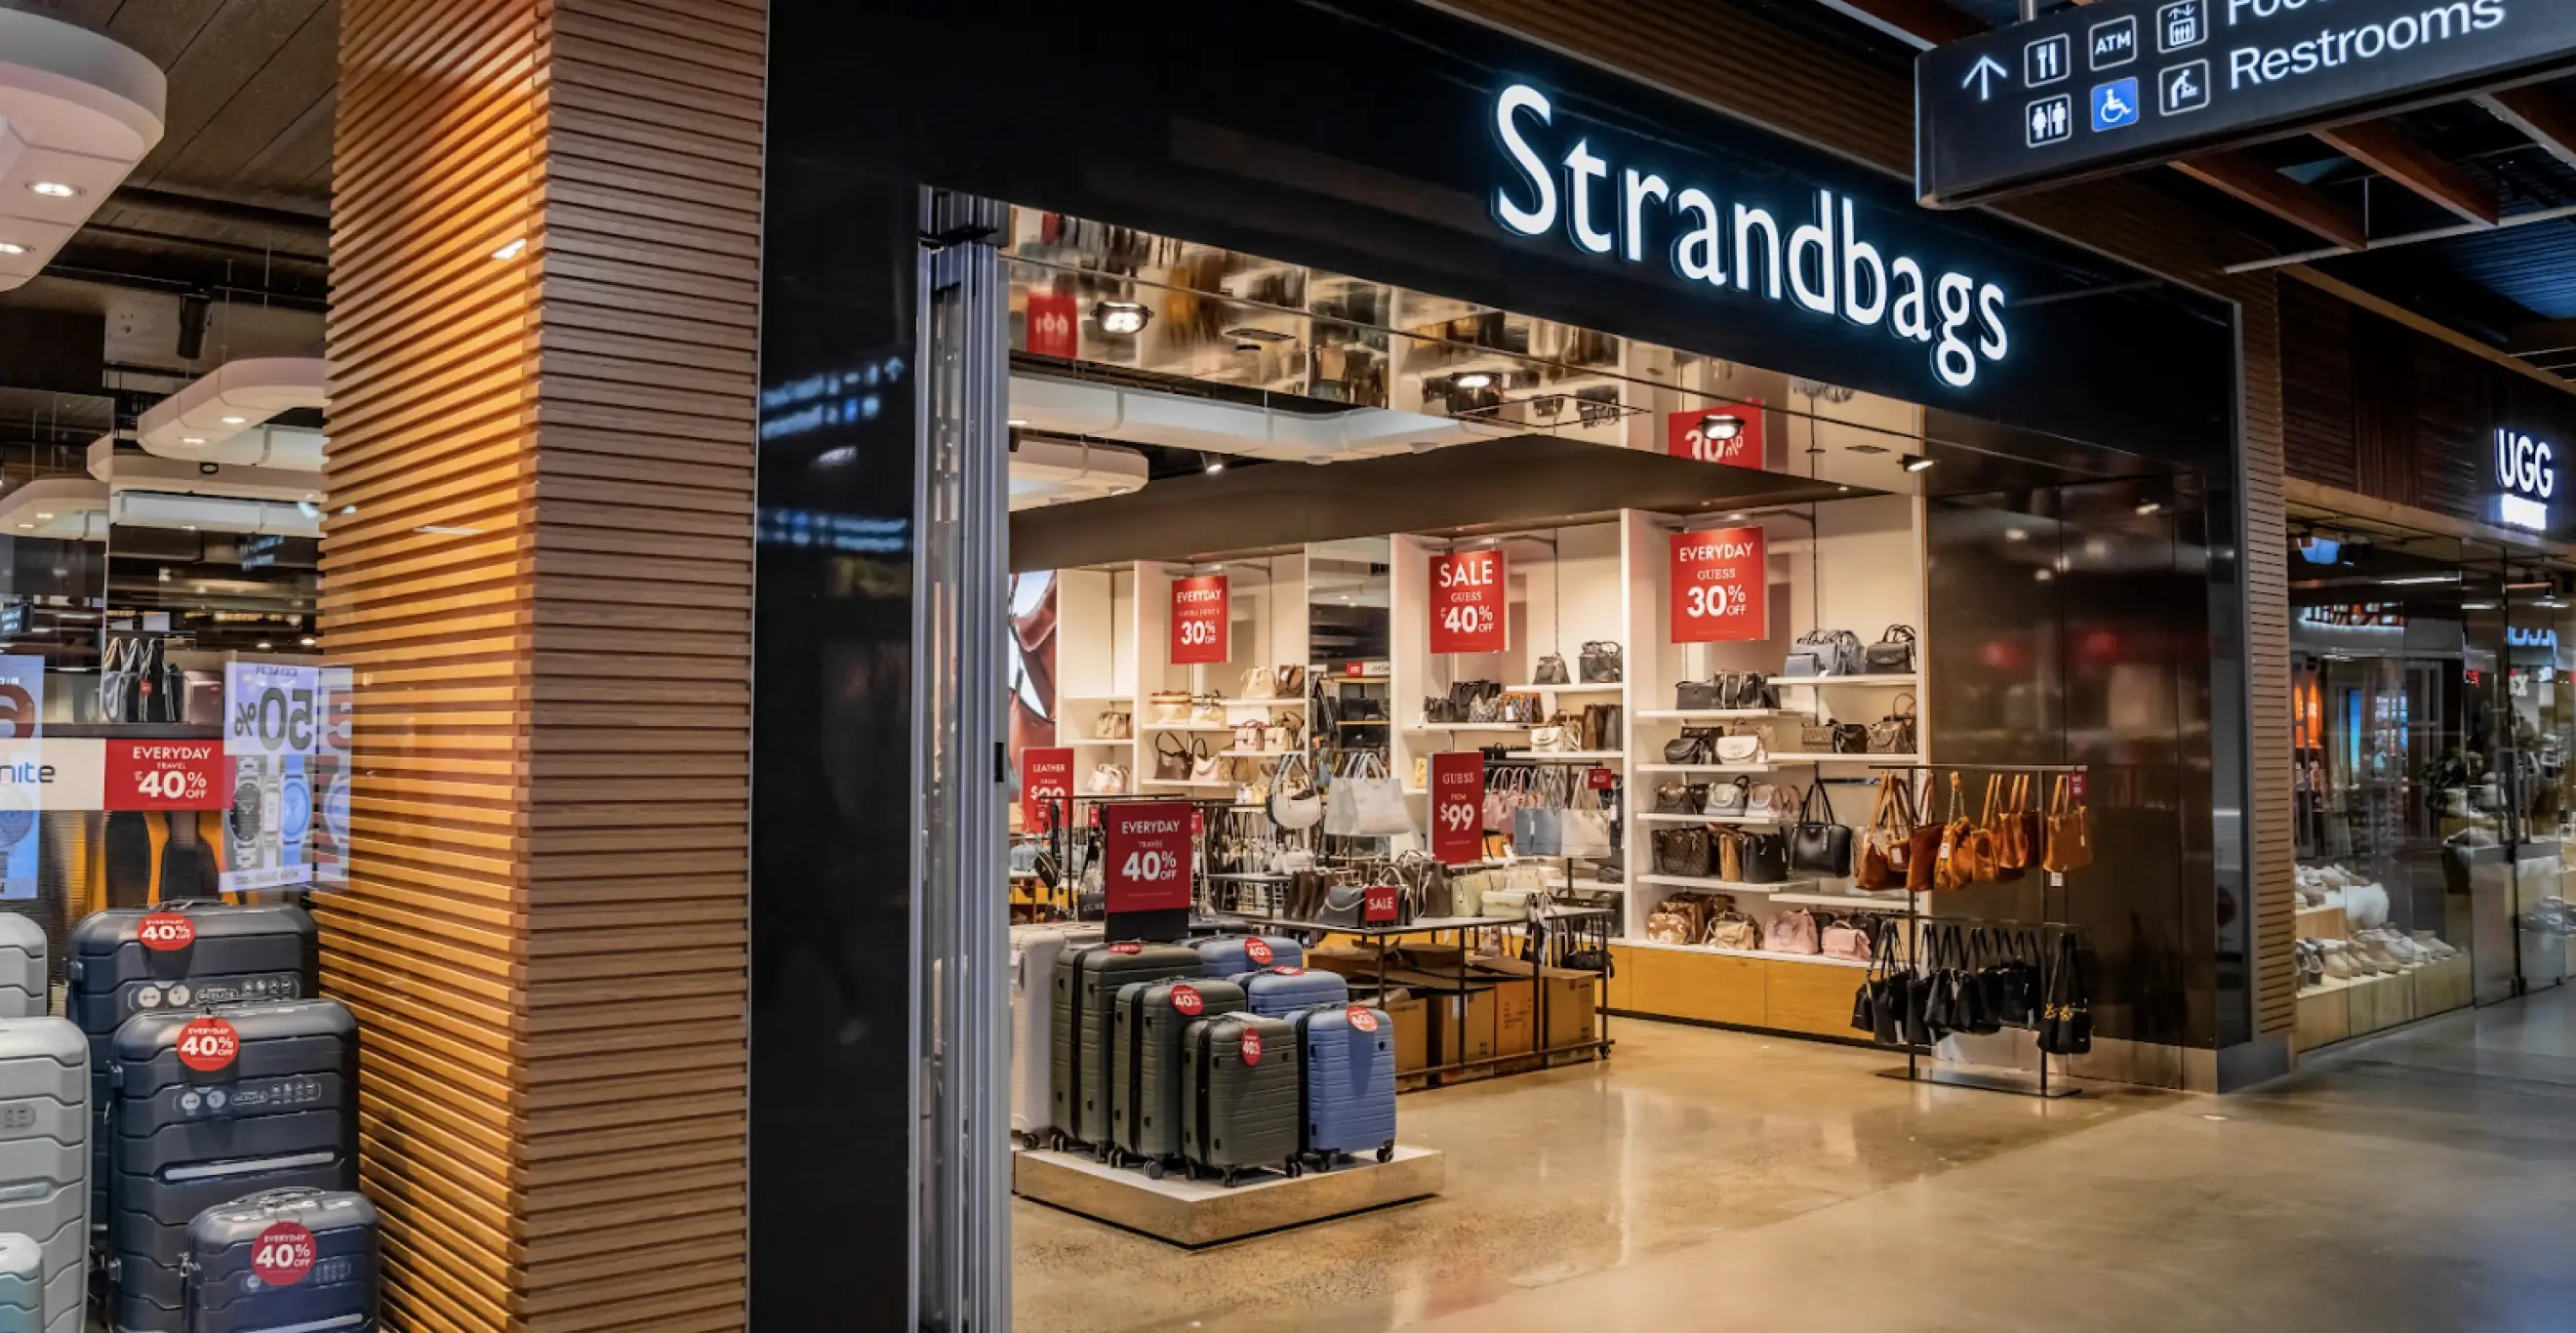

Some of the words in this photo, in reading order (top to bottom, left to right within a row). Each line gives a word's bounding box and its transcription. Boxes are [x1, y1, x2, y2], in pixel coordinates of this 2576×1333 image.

[2094, 30, 2132, 55] ATM
[2229, 0, 2507, 90] Restrooms
[1495, 84, 2008, 386] Strandbags
[2495, 427, 2554, 498] UGG
[1679, 543, 1754, 562] EVERYDAY
[1439, 559, 1493, 587] SALE
[1697, 568, 1736, 581] GUESS
[1176, 588, 1222, 604] EVERYDAY
[1450, 591, 1483, 603] GUESS
[1686, 585, 1746, 618] 30%
[1726, 605, 1747, 616] OFF
[1444, 605, 1494, 633] 40%
[1478, 624, 1494, 632] OFF
[1181, 620, 1216, 645] 30%
[133, 747, 212, 760] EVERYDAY
[156, 761, 187, 770] TRAVEL
[1032, 763, 1066, 773] LEATHER
[138, 770, 208, 799] 40%
[185, 789, 208, 799] OFF
[1442, 772, 1475, 785] GUESS
[1451, 791, 1467, 801] FROM
[1438, 802, 1475, 831] $99
[1121, 820, 1181, 834] EVERYDAY
[1139, 839, 1163, 849] TRAVEL
[1122, 850, 1177, 881] 40%
[1160, 869, 1178, 880] OFF
[1368, 896, 1394, 911] SALE
[141, 925, 191, 941] 40%
[187, 1027, 230, 1035] EVERYDAY
[181, 1035, 234, 1057] 40%
[263, 1233, 307, 1243] EVERYDAY
[256, 1243, 310, 1269] 40%
[294, 1258, 310, 1268] OFF
